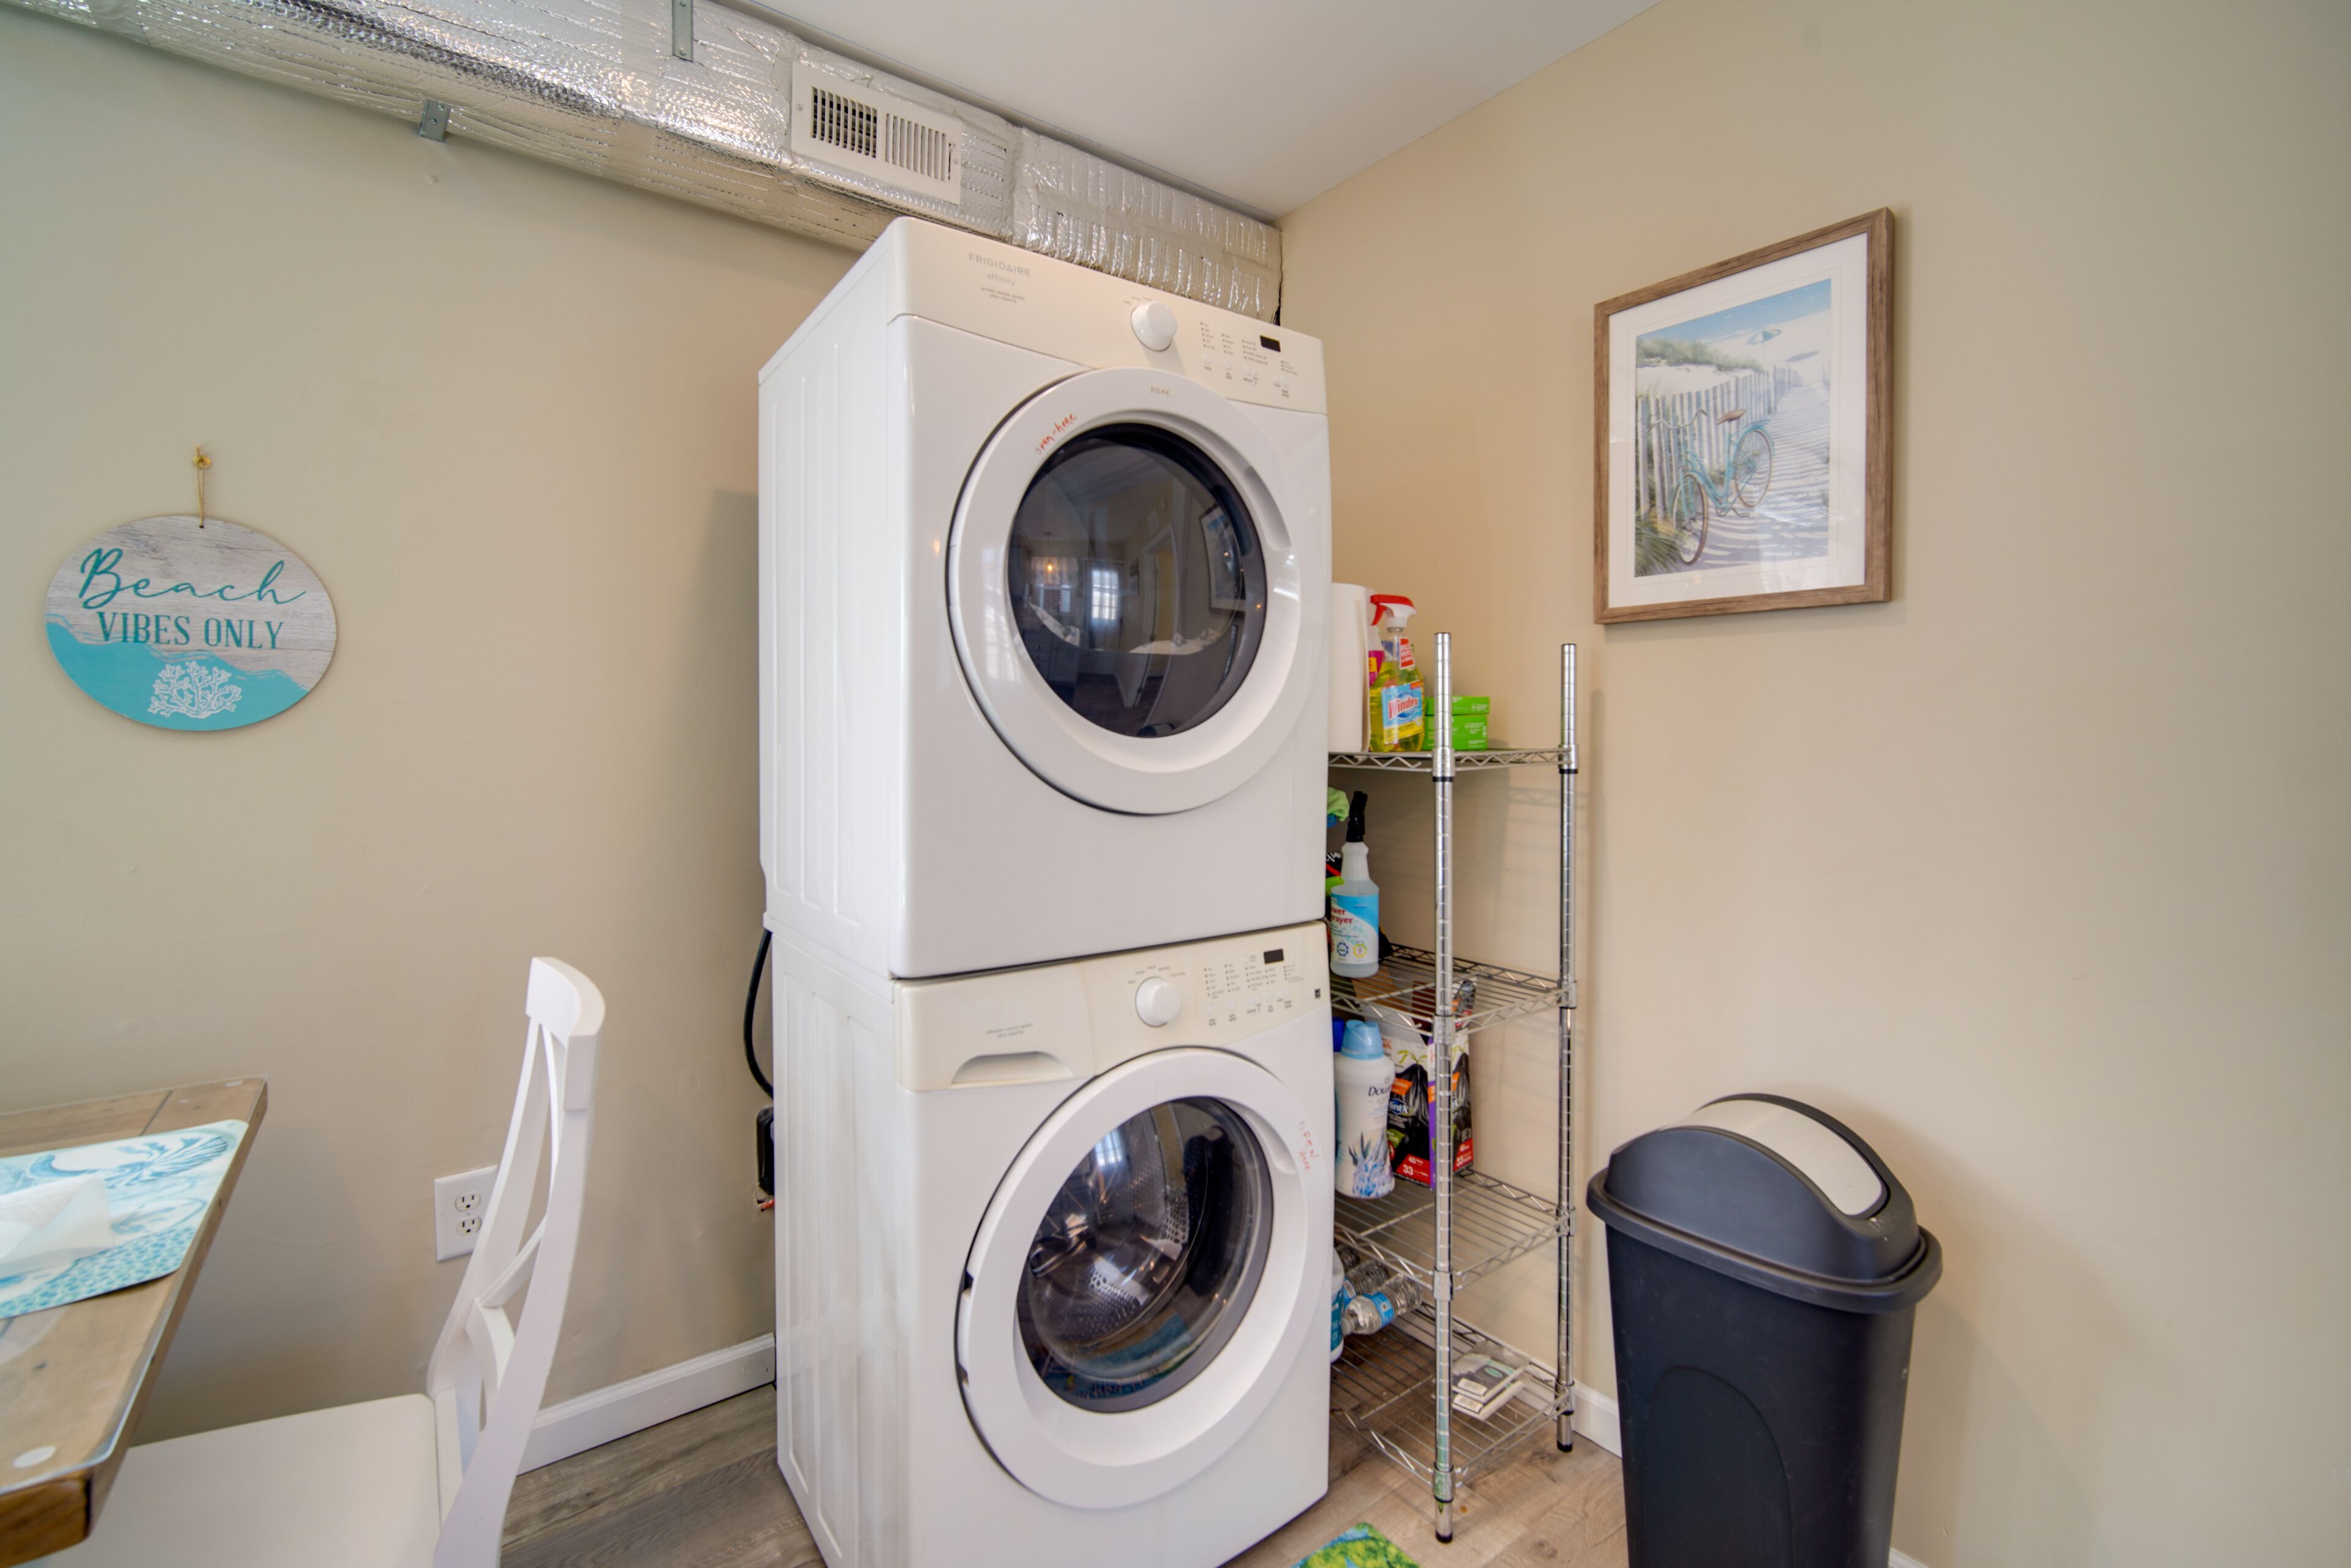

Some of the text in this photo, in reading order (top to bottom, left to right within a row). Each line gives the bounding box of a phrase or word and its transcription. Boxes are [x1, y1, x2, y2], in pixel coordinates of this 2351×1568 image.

[969, 253, 1031, 277] FRIGIDAIRE
[987, 273, 1016, 287] affinity
[78, 547, 307, 610] Beach
[96, 611, 285, 650] VIBES ONLY
[1388, 697, 1419, 719] Windex
[1331, 915, 1354, 925] rayer
[1403, 1164, 1414, 1176] 33
